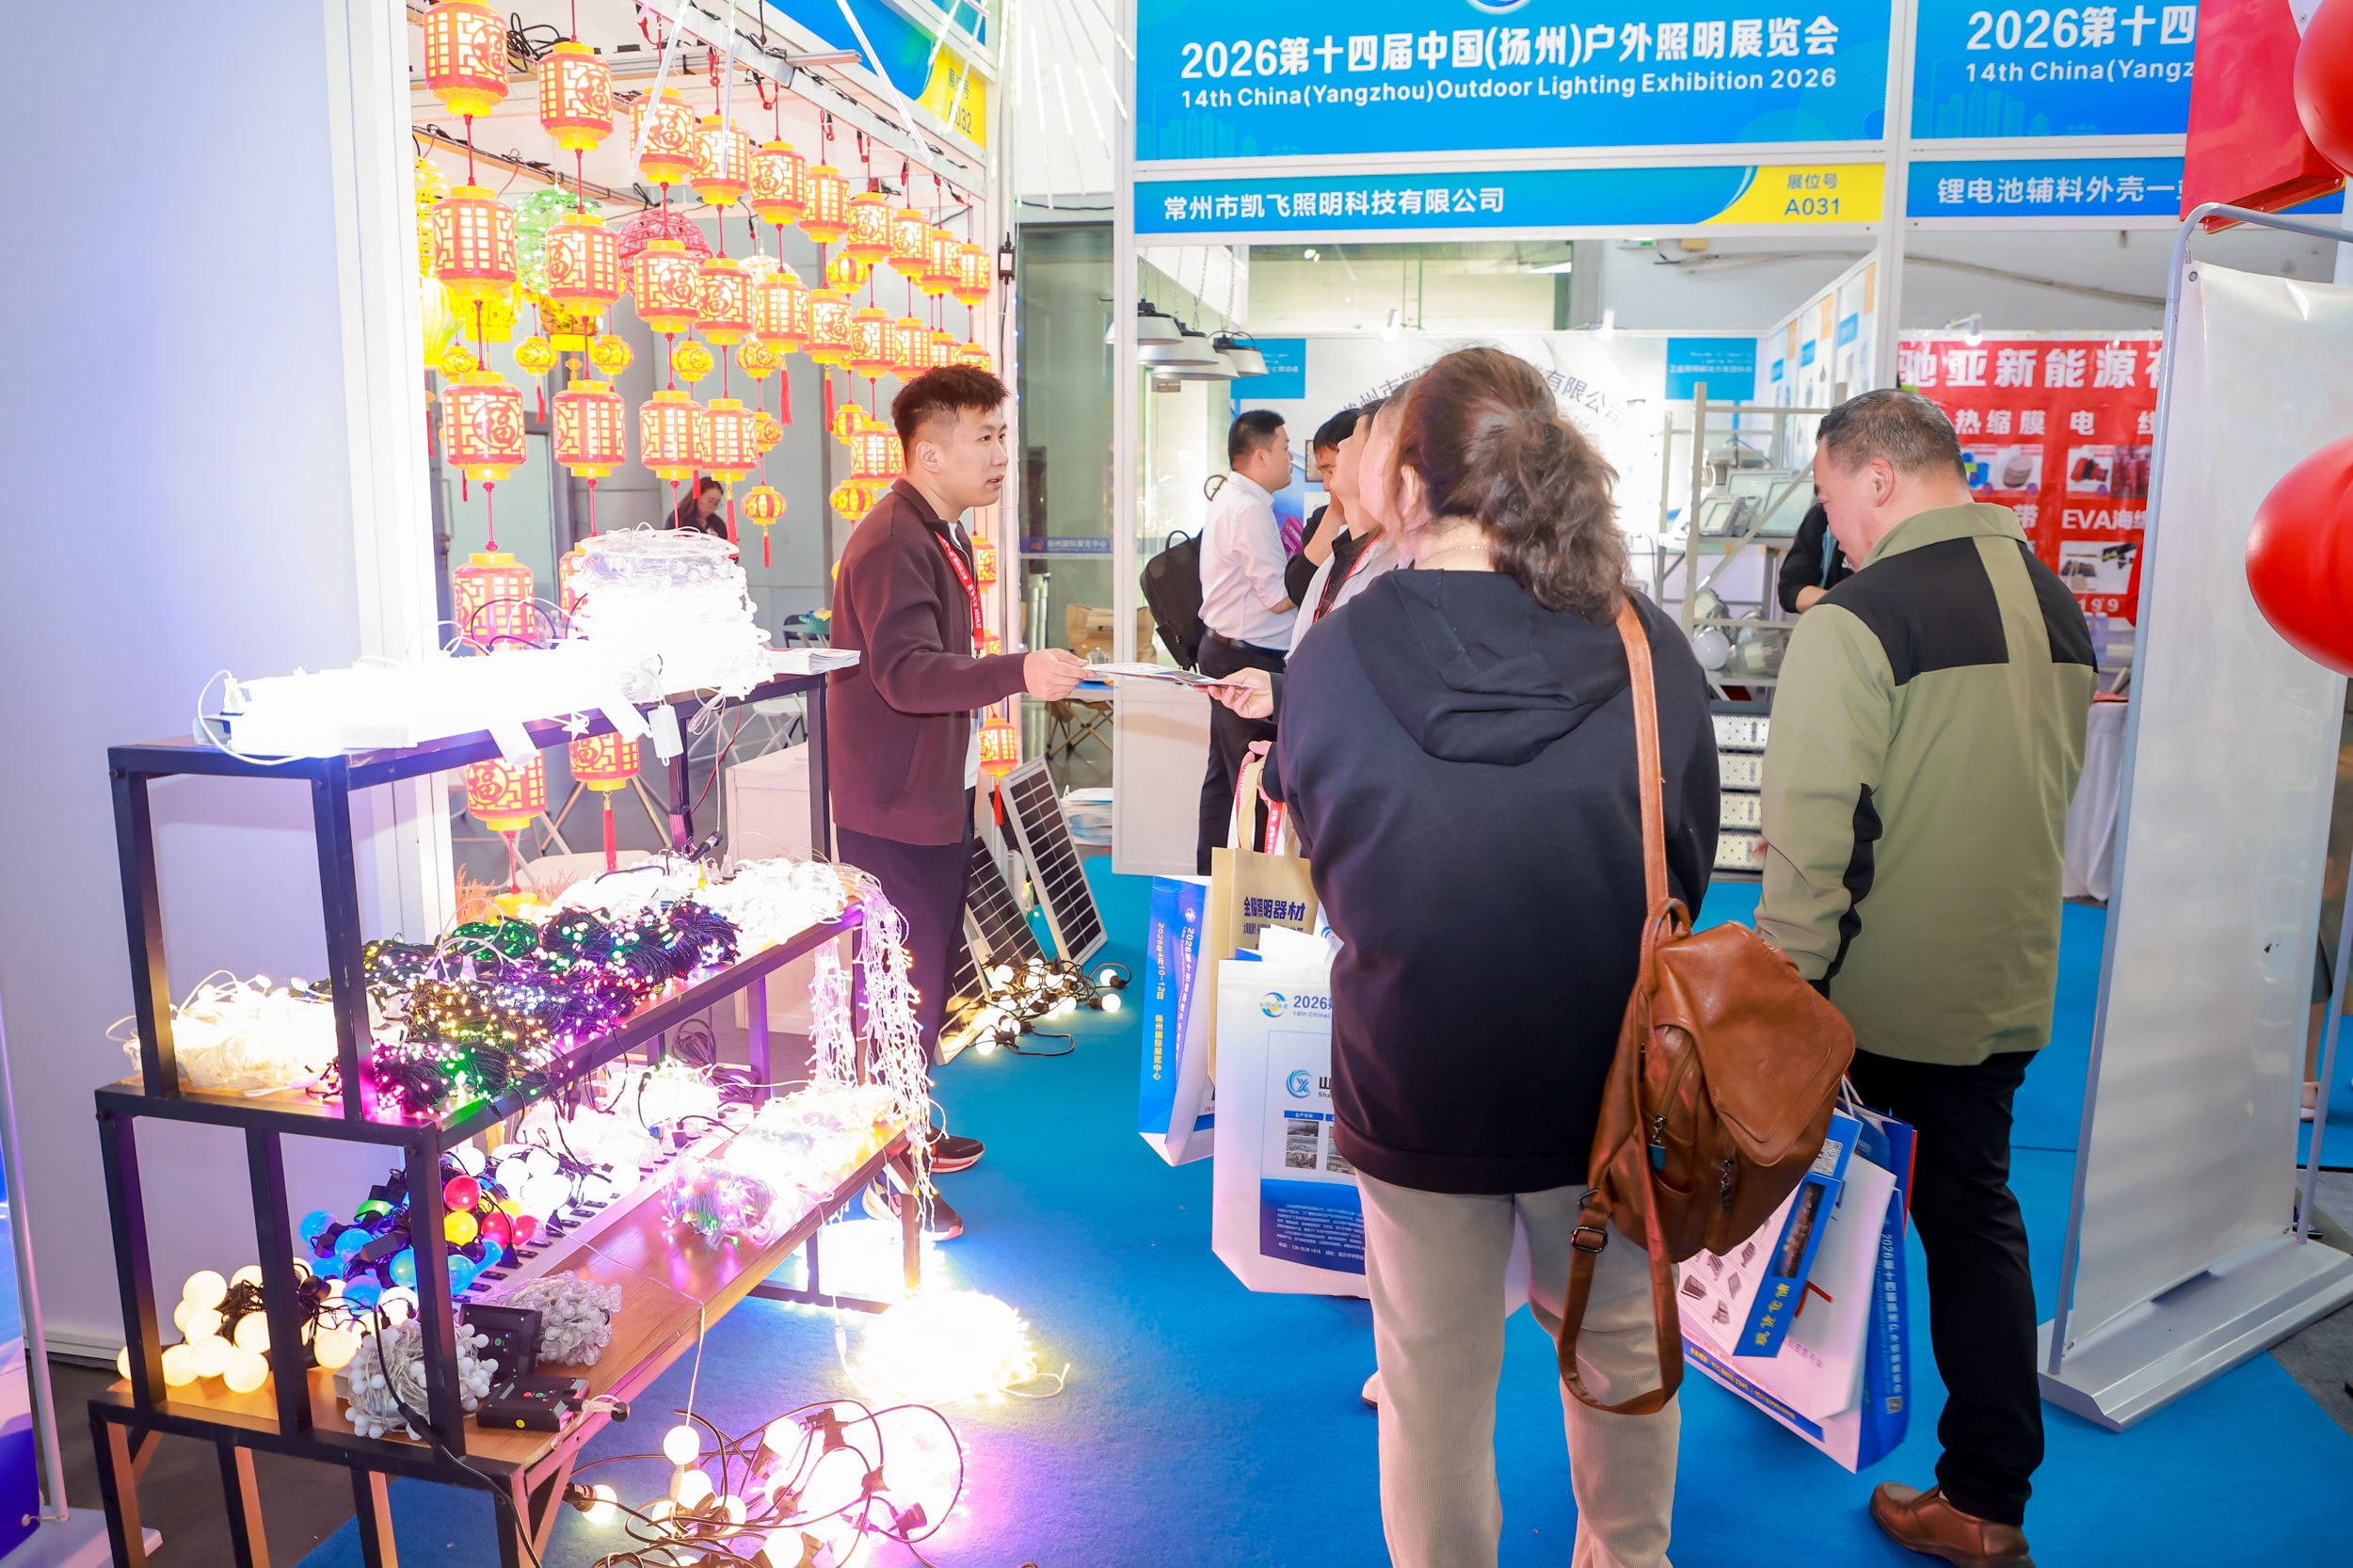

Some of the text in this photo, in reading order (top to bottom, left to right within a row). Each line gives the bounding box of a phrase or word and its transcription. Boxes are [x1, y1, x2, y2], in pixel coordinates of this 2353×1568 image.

[1180, 16, 1839, 79] 2026第十四届中国(扬州)户外照明展览会
[1966, 5, 2198, 51] 2026第十四
[1181, 68, 1836, 108] 14th China(Yangzhou)Outdoor Lighting Exhibition 2026
[1966, 62, 2024, 83] 14th
[1787, 173, 1838, 189] 展位号
[1163, 187, 1504, 221] 常州市凯飞照明科技有限公司
[1785, 197, 1840, 216] A031
[660, 264, 696, 302] 福
[699, 280, 732, 316] 福
[473, 402, 519, 447] 福
[1955, 408, 2046, 436] 热缩膜
[2070, 410, 2095, 436] 电
[468, 760, 507, 805] 福
[1156, 922, 1165, 1000] 2026年4月10-12日
[1152, 1015, 1164, 1080] 扬州国际展览中心
